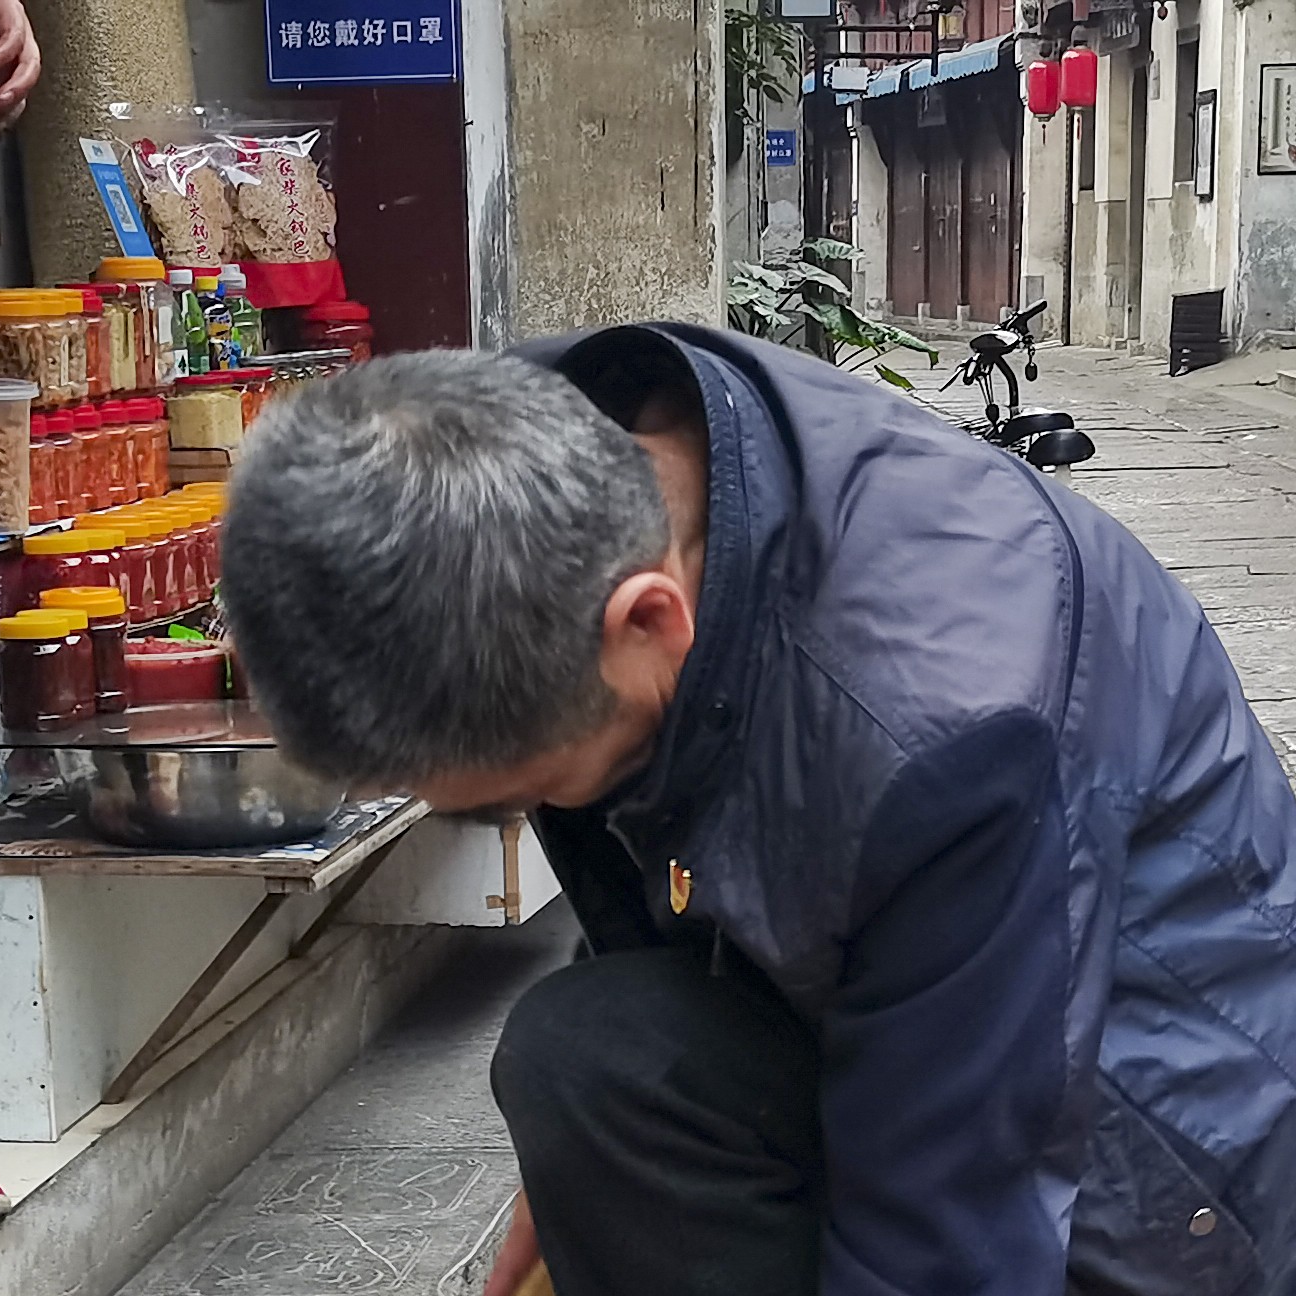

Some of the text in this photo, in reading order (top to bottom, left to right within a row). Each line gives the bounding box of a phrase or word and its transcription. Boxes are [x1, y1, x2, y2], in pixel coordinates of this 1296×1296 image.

[279, 17, 443, 49] 请您戴好口罩
